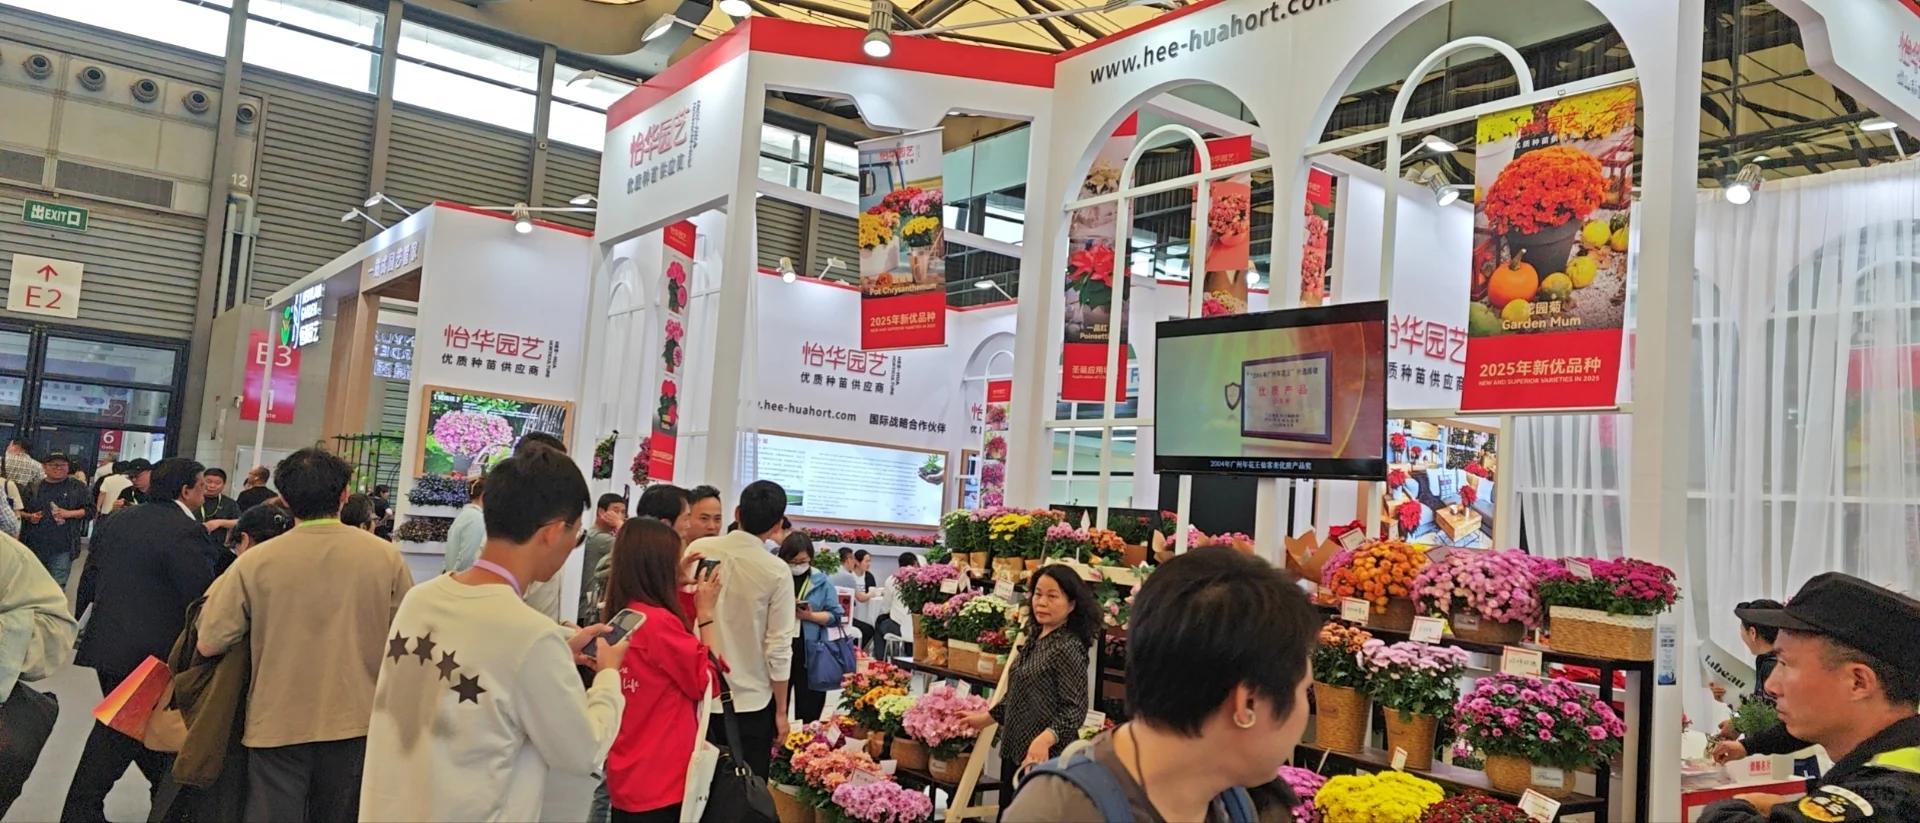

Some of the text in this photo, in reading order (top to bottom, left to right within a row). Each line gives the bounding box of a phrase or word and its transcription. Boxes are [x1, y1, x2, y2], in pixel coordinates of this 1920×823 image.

[1090, 0, 1331, 84] www.hee-huahort.co
[630, 107, 690, 168] 怡华园艺
[231, 173, 248, 187] 12
[25, 286, 62, 310] E2
[869, 283, 937, 296] Pot Chrysanthemum
[870, 311, 936, 327] 2025年新优品种
[1502, 316, 1581, 330] Garden Mum
[444, 324, 544, 360] 怡华园艺
[441, 353, 539, 376] 优质种苗供应商
[802, 341, 889, 377] 怡华园艺
[1479, 356, 1602, 378] 2025年新优品种
[800, 372, 885, 394] 优质种苗供应商
[1259, 384, 1308, 397] 优质产品
[1507, 377, 1540, 385] SUPERIOR
[869, 413, 947, 434] 国际战略合作伙伴
[103, 430, 114, 444] 6
[623, 678, 640, 693] Life
